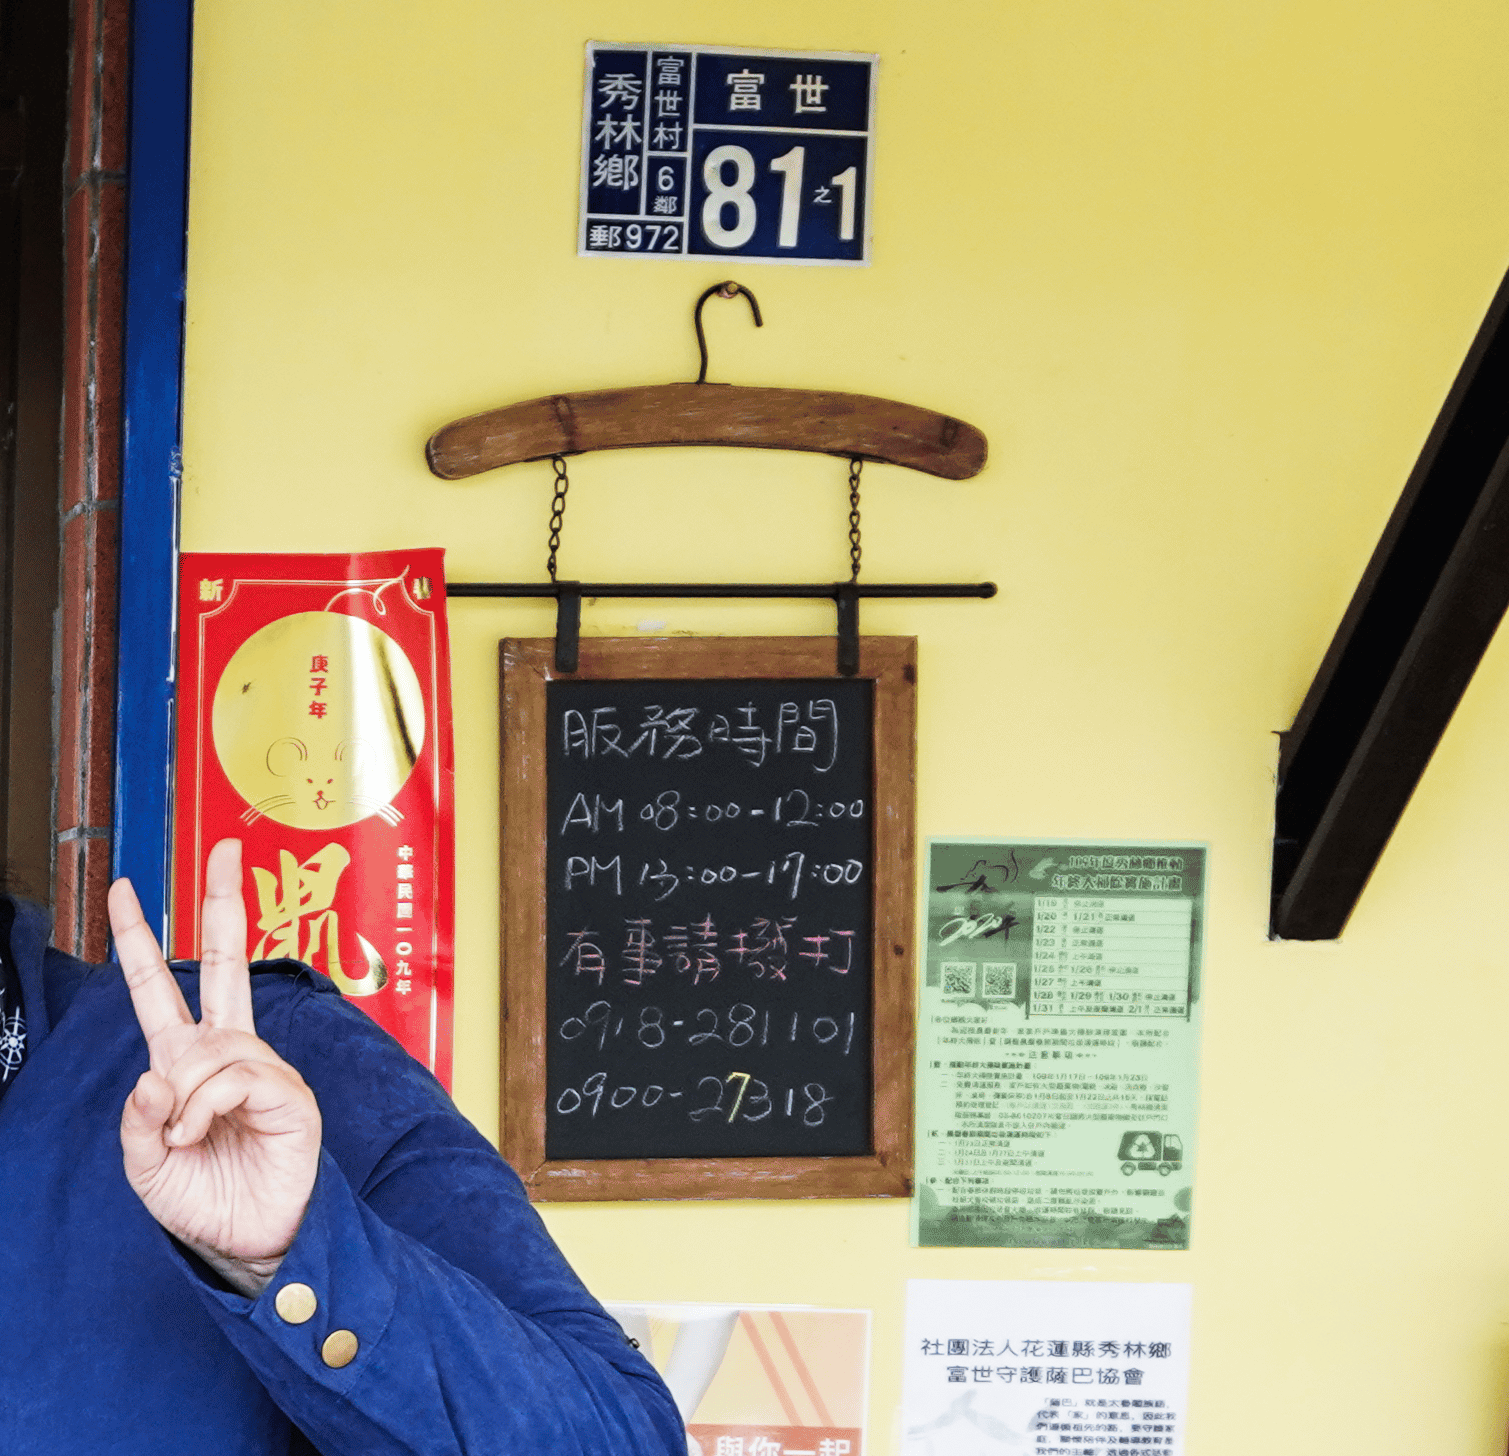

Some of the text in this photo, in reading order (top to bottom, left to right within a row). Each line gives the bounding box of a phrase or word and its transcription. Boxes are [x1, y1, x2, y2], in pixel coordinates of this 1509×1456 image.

[653, 55, 684, 150] 富世村
[726, 68, 829, 114] 富世
[592, 72, 643, 192] 秀林鄉
[653, 165, 678, 215] 6鄰
[589, 223, 680, 251] 郵972
[199, 578, 223, 601] 新
[308, 654, 329, 719] 庚子年
[563, 698, 839, 772] 服務時間
[560, 792, 624, 836] AM
[565, 854, 623, 896] PM
[921, 1338, 1172, 1359] 社團法人花蓮縣秀林鄉
[946, 1365, 1145, 1386] 富世守護薩巴協會
